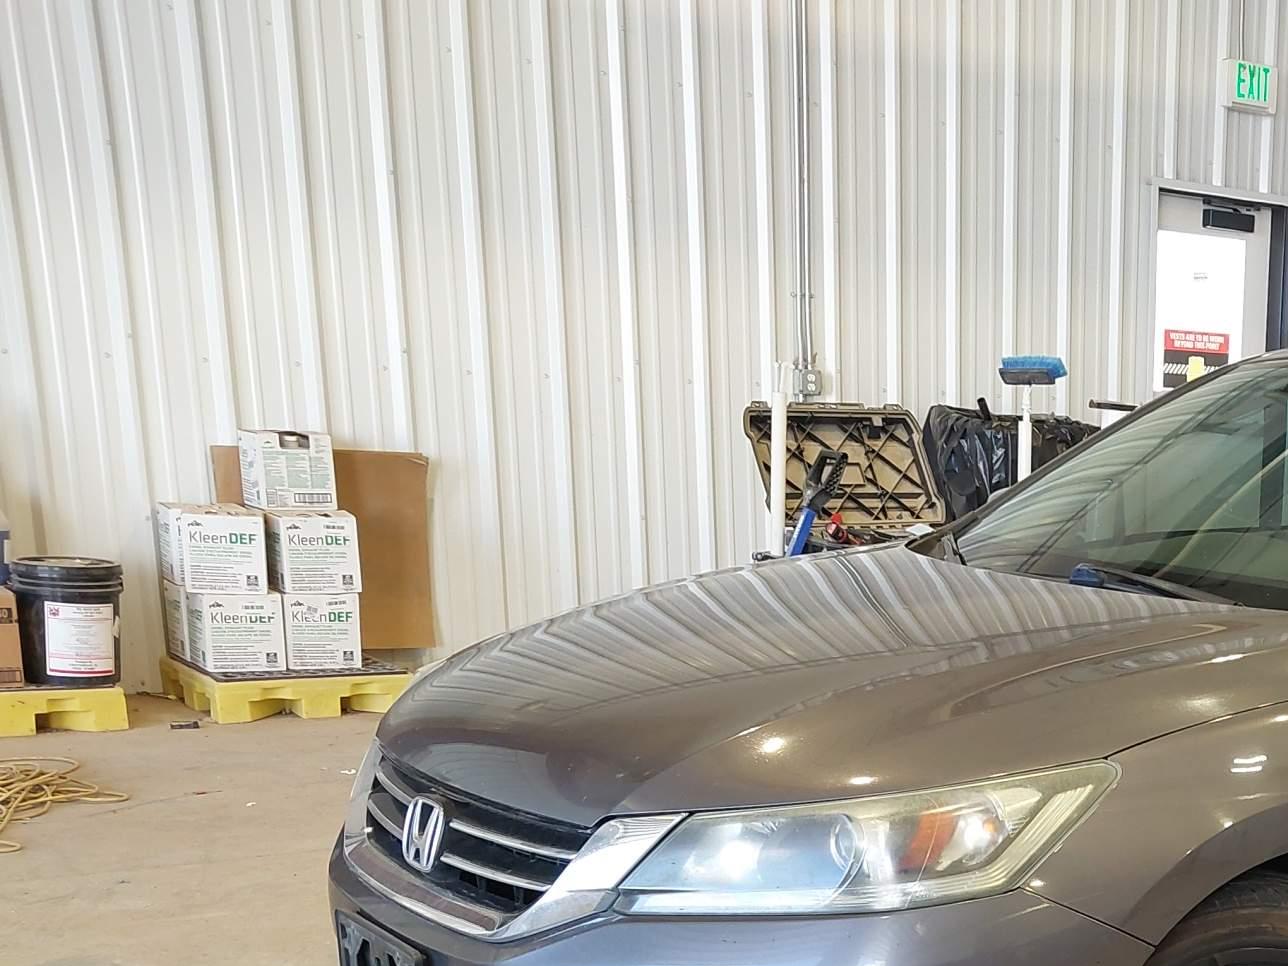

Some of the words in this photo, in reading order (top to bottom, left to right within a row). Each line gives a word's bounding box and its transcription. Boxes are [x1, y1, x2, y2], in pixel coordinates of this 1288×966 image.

[1237, 62, 1270, 102] EXIT
[188, 530, 258, 545] KleenDEF
[287, 534, 351, 546] KleenDEF
